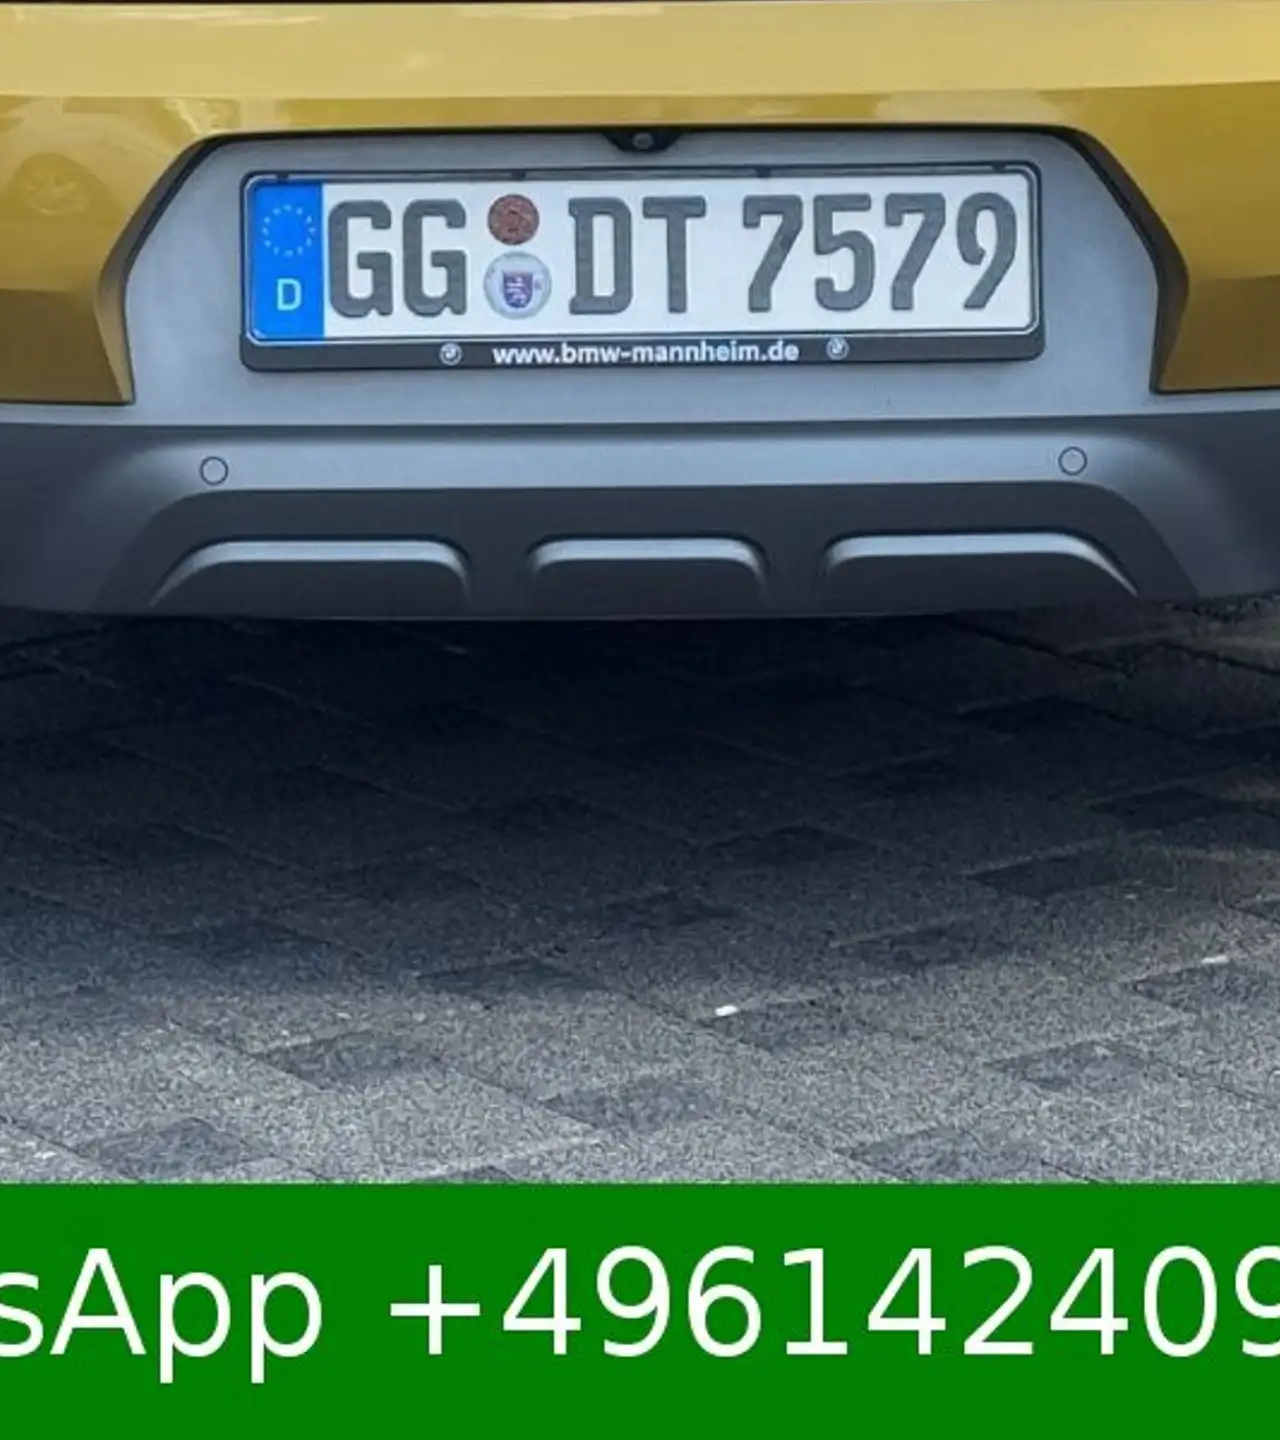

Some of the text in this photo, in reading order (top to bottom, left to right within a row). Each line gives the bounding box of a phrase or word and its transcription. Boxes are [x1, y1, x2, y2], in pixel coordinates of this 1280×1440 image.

[327, 198, 468, 319] GG
[568, 194, 707, 316] DT
[741, 190, 1019, 315] 7579
[276, 277, 303, 311] D
[492, 340, 801, 366] www.bmw-mannheim.de
